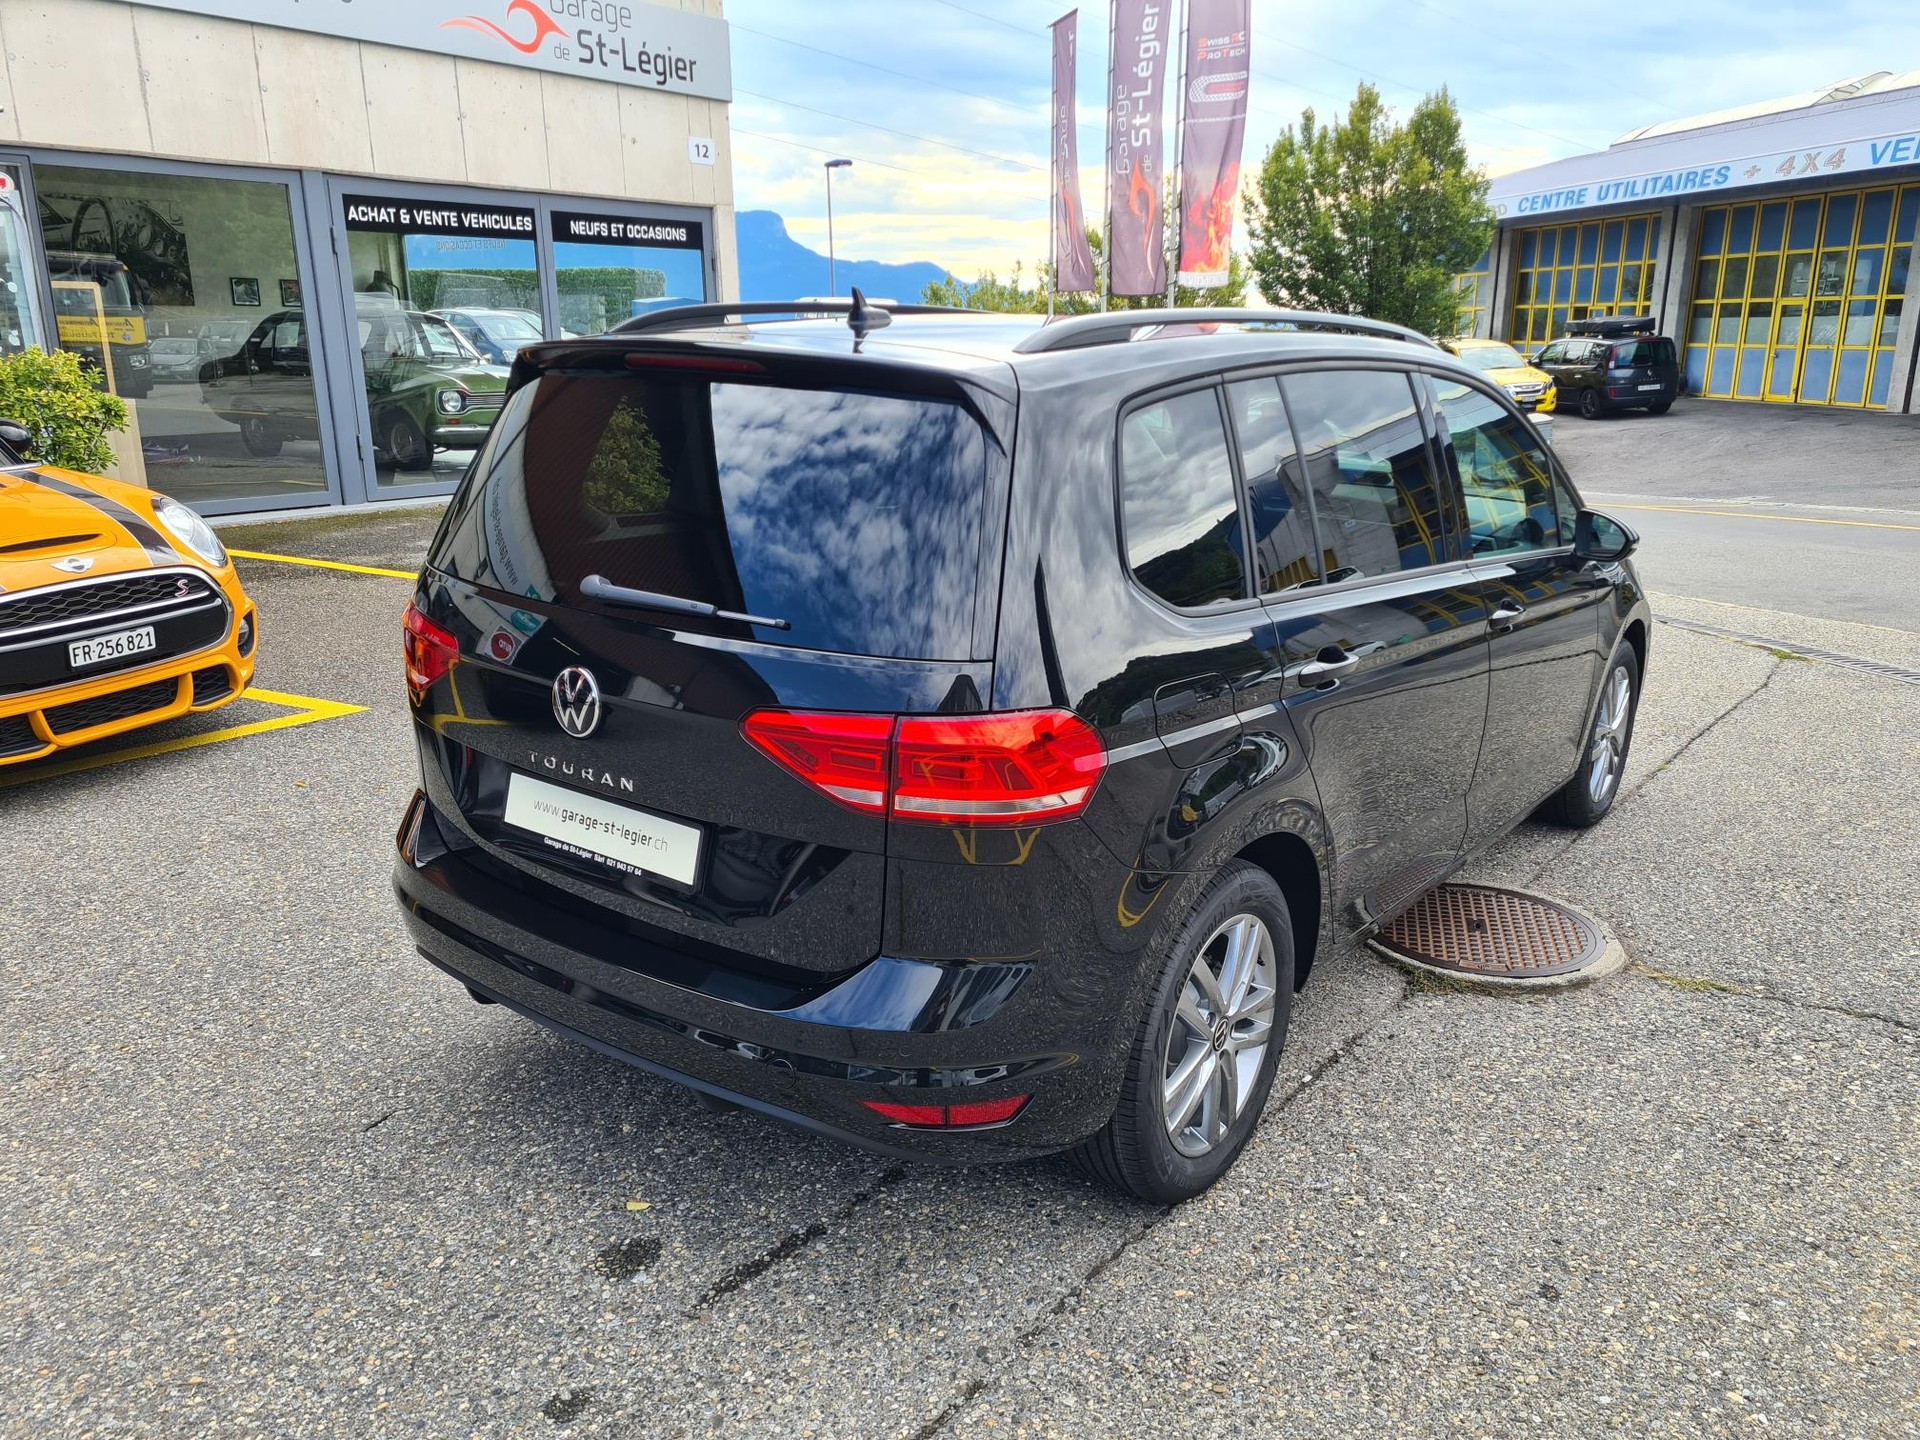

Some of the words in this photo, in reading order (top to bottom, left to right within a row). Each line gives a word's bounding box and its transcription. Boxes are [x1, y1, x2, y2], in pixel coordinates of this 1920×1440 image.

[553, 42, 571, 61] de
[576, 29, 697, 86] St-Légier
[1131, 3, 1160, 148] St-Légier
[694, 143, 709, 159] 12
[1517, 187, 1589, 213] CENTRE
[1596, 165, 1731, 202] UTILITAIRES
[1775, 147, 1847, 177] 4X4
[1869, 136, 1920, 166] VE
[348, 205, 397, 224] ACHAT
[399, 208, 410, 224] &
[413, 209, 459, 228] VENTE
[461, 212, 533, 231] VEHICULES
[569, 219, 609, 238] NEUFS
[611, 222, 625, 239] ET
[626, 223, 687, 242] OCCASIONS
[175, 579, 189, 598] S
[126, 630, 153, 651] 821
[529, 751, 634, 793] TOURAN
[533, 799, 668, 852] www.garage-st-legier.ch
